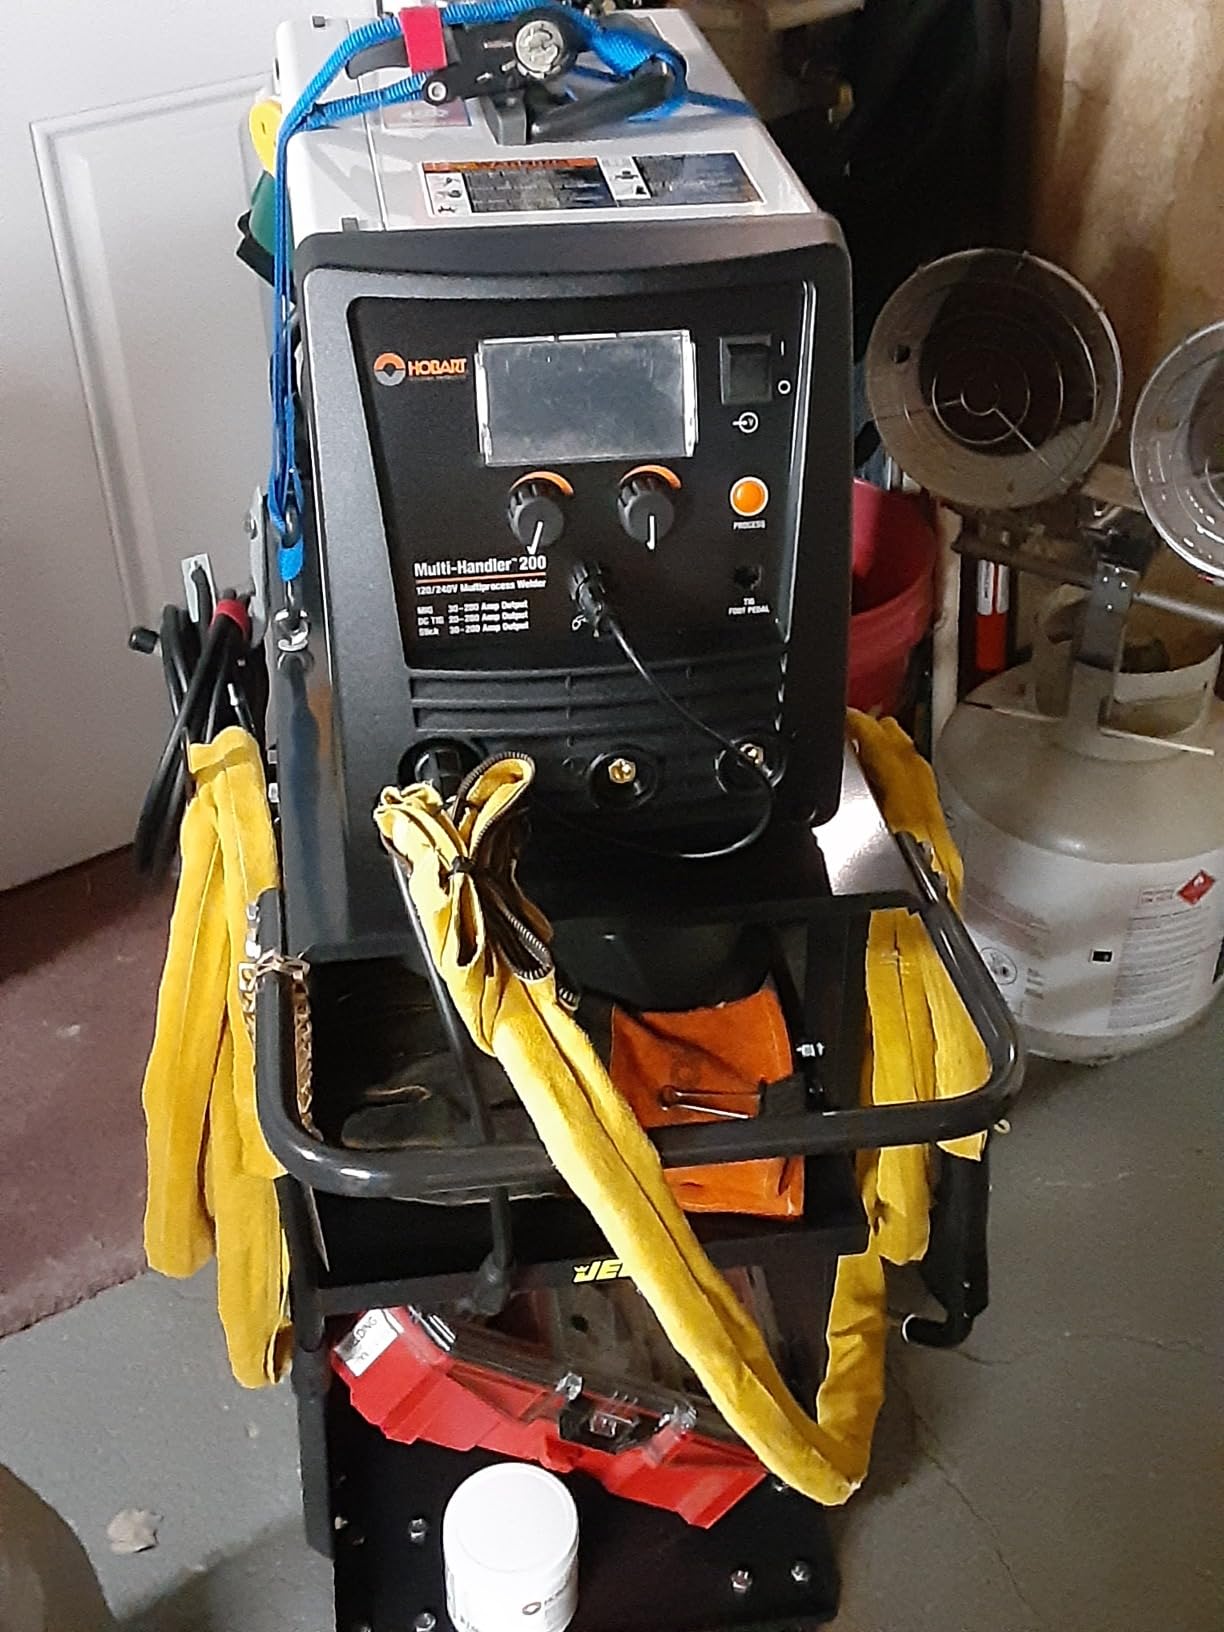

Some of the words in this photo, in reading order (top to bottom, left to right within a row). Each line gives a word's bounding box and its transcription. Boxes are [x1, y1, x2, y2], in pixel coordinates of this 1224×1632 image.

[407, 358, 467, 376] HOBART
[519, 555, 547, 571] 200
[460, 581, 515, 593] Multiprocess
[517, 579, 547, 589] Welder
[481, 602, 500, 611] Amp
[417, 616, 430, 626] DC
[481, 612, 500, 622] Amp
[482, 623, 501, 633] Amp
